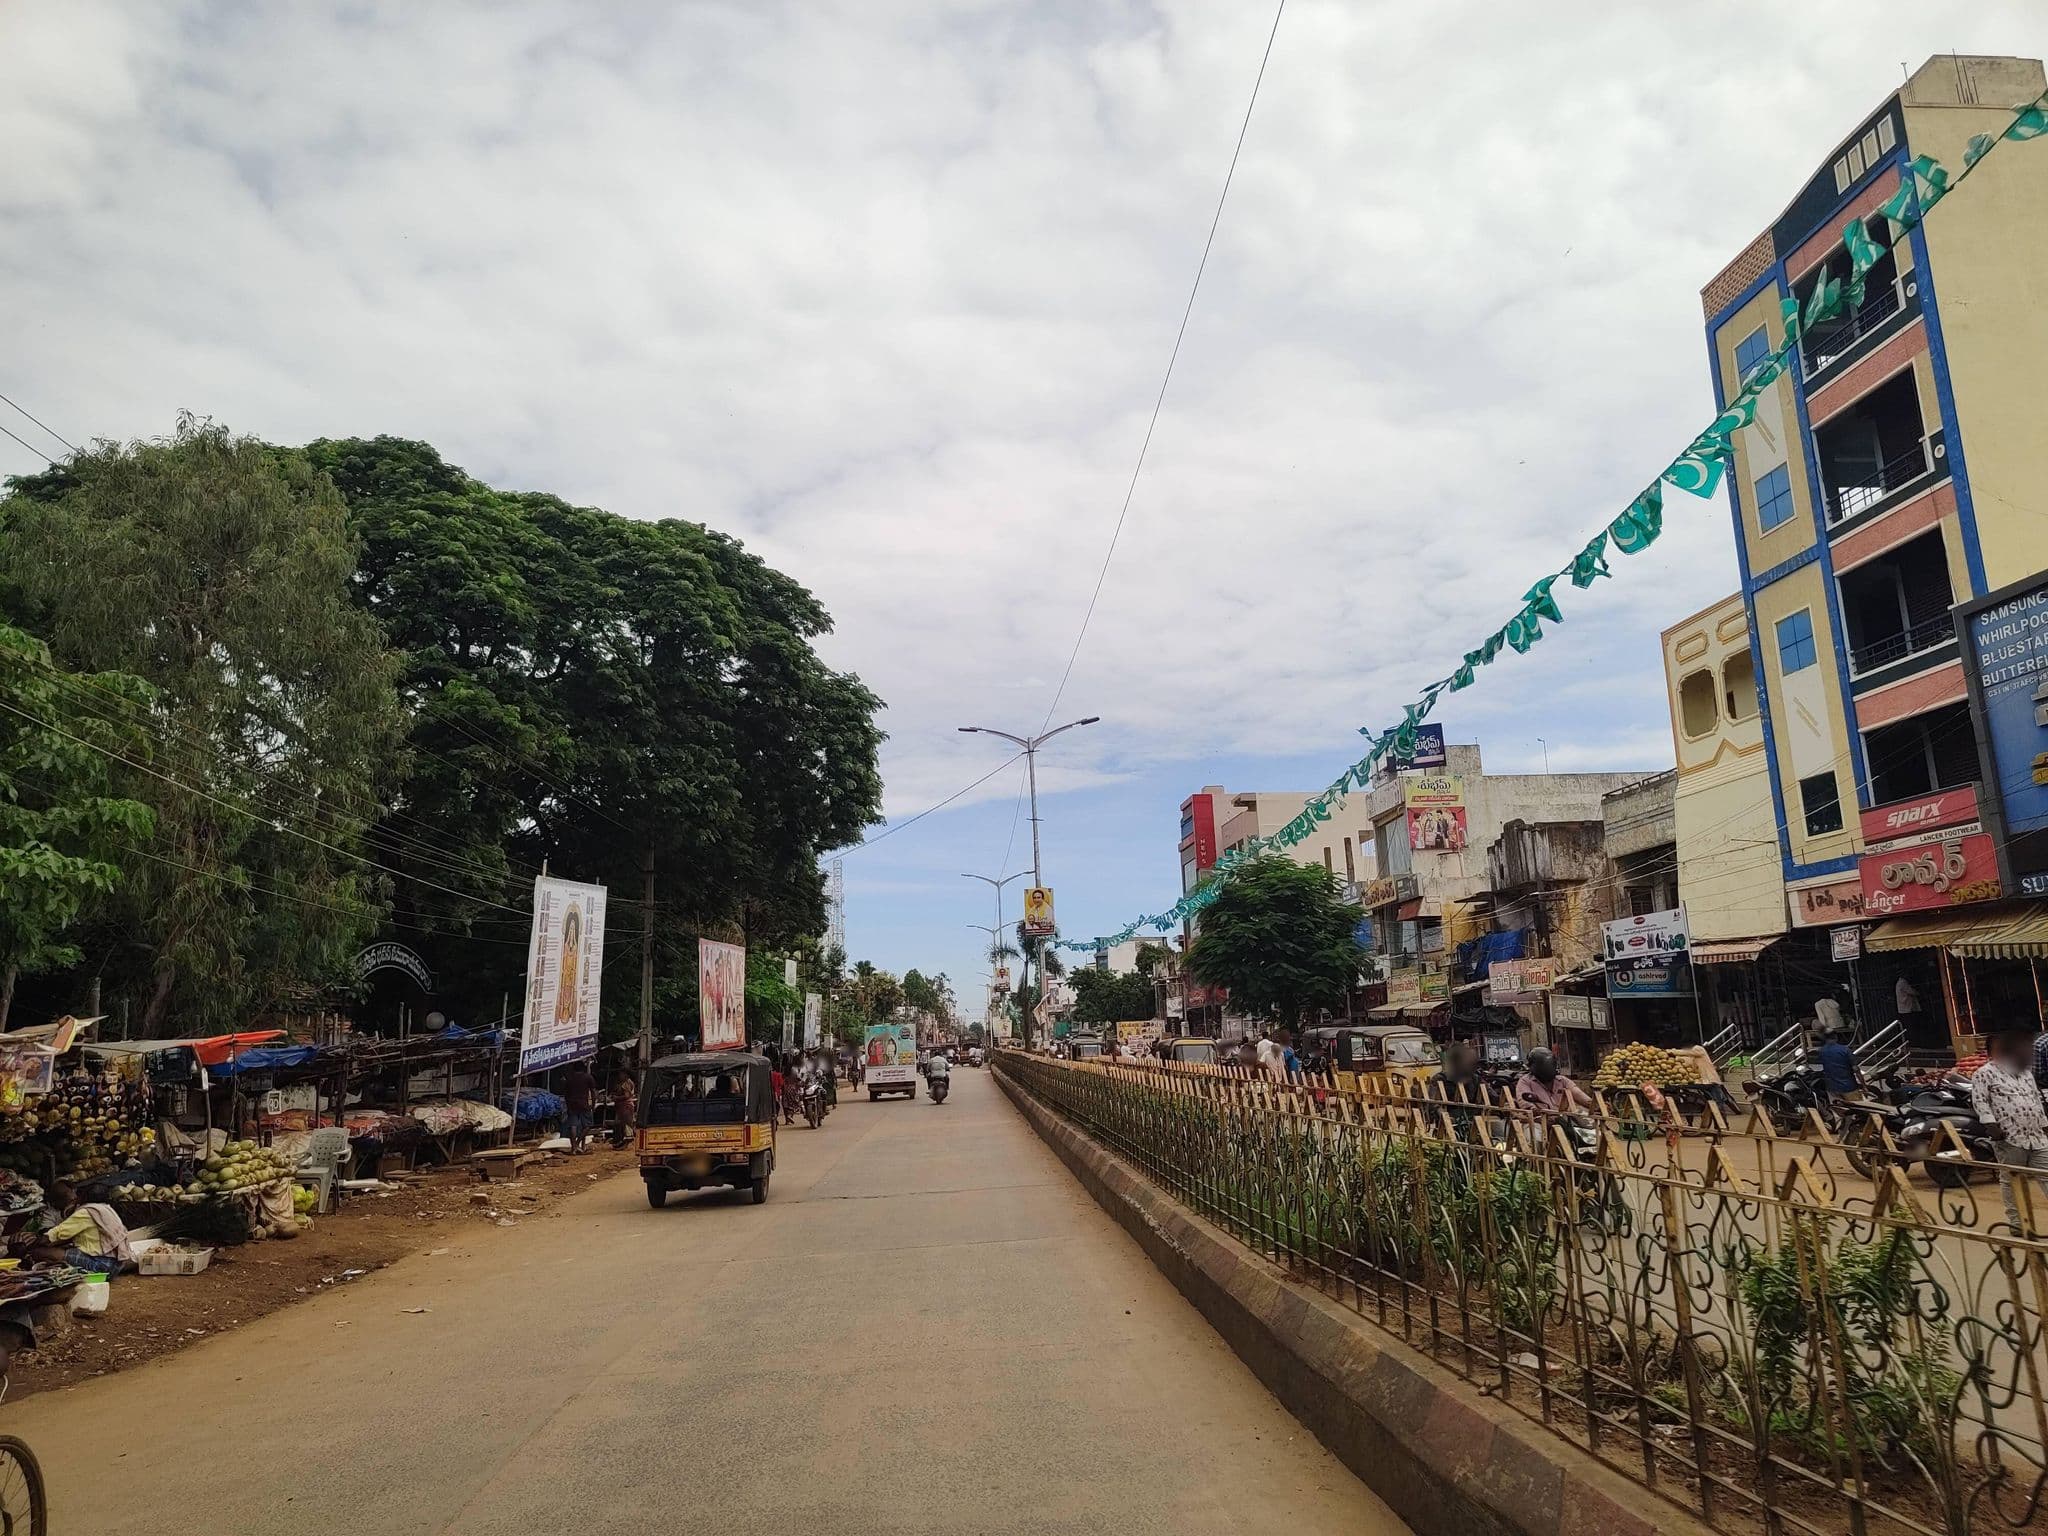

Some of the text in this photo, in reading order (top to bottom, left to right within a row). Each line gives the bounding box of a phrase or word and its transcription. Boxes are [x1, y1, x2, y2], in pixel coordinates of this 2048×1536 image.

[1981, 592, 2048, 625] SAMSUNG
[1886, 798, 1944, 828] sparx
[1920, 825, 1979, 843] LANCER FOOTWEAR
[1865, 891, 1905, 911] Lancer
